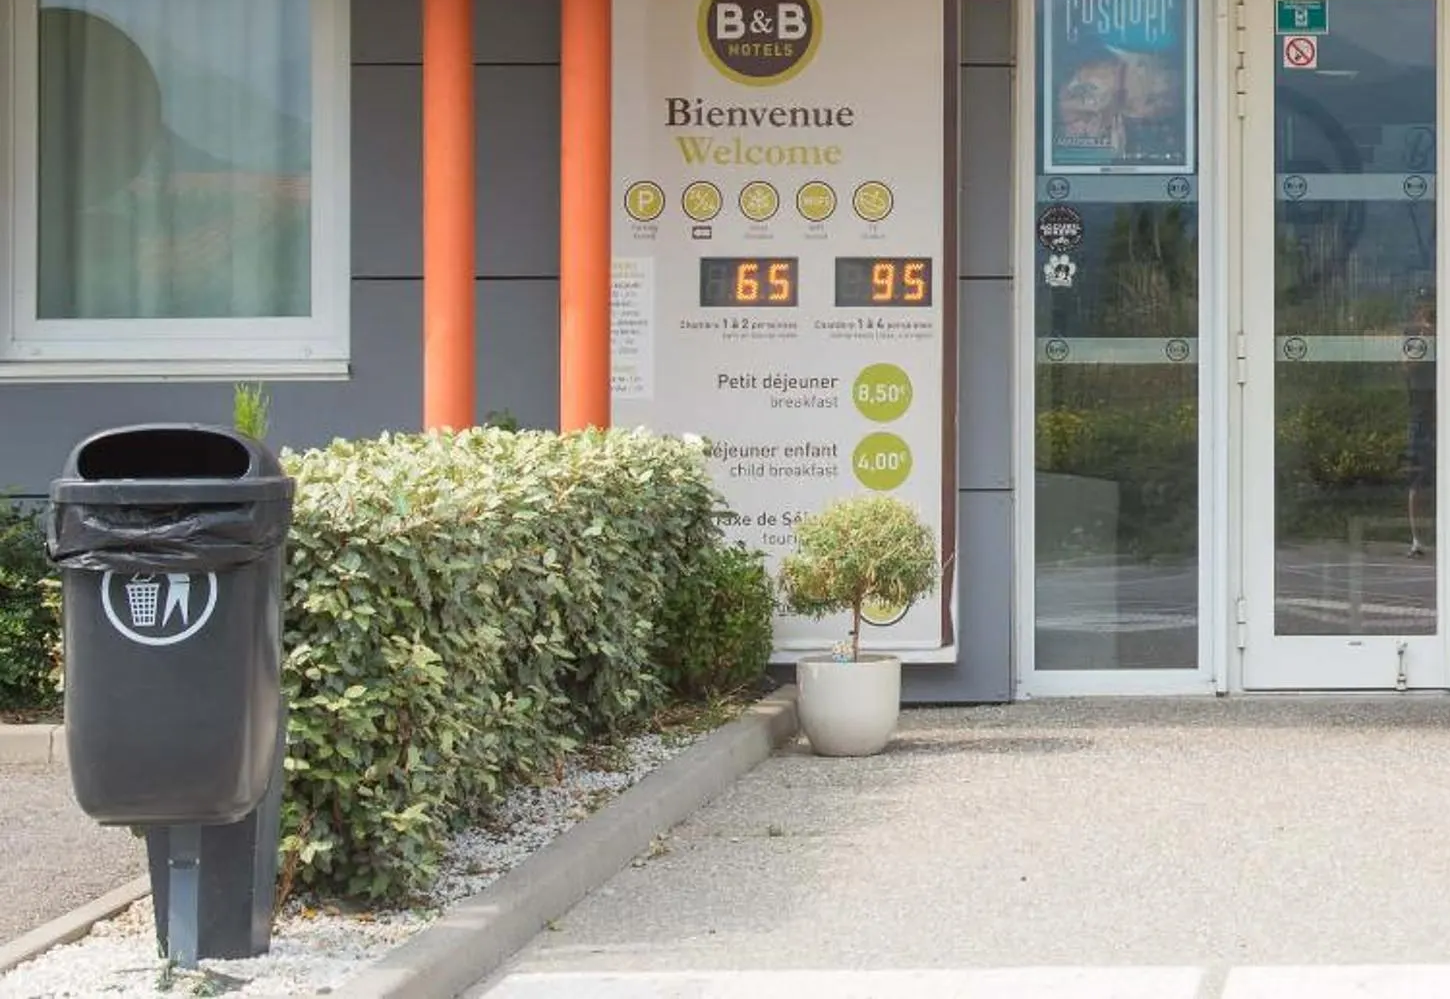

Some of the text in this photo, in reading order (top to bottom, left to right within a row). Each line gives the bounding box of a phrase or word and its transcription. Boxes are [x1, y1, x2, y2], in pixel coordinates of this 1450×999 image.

[716, 2, 807, 40] B&B
[728, 43, 794, 57] HOTELS
[664, 97, 855, 128] Bienvenue
[675, 135, 843, 166] Welcome
[736, 262, 791, 301] 65
[871, 262, 926, 301] 95
[718, 369, 839, 392] Petit déjeuner
[771, 394, 839, 408] breakfast
[784, 442, 838, 457] enfant
[730, 462, 839, 477] child breakfast
[757, 510, 778, 526] de
